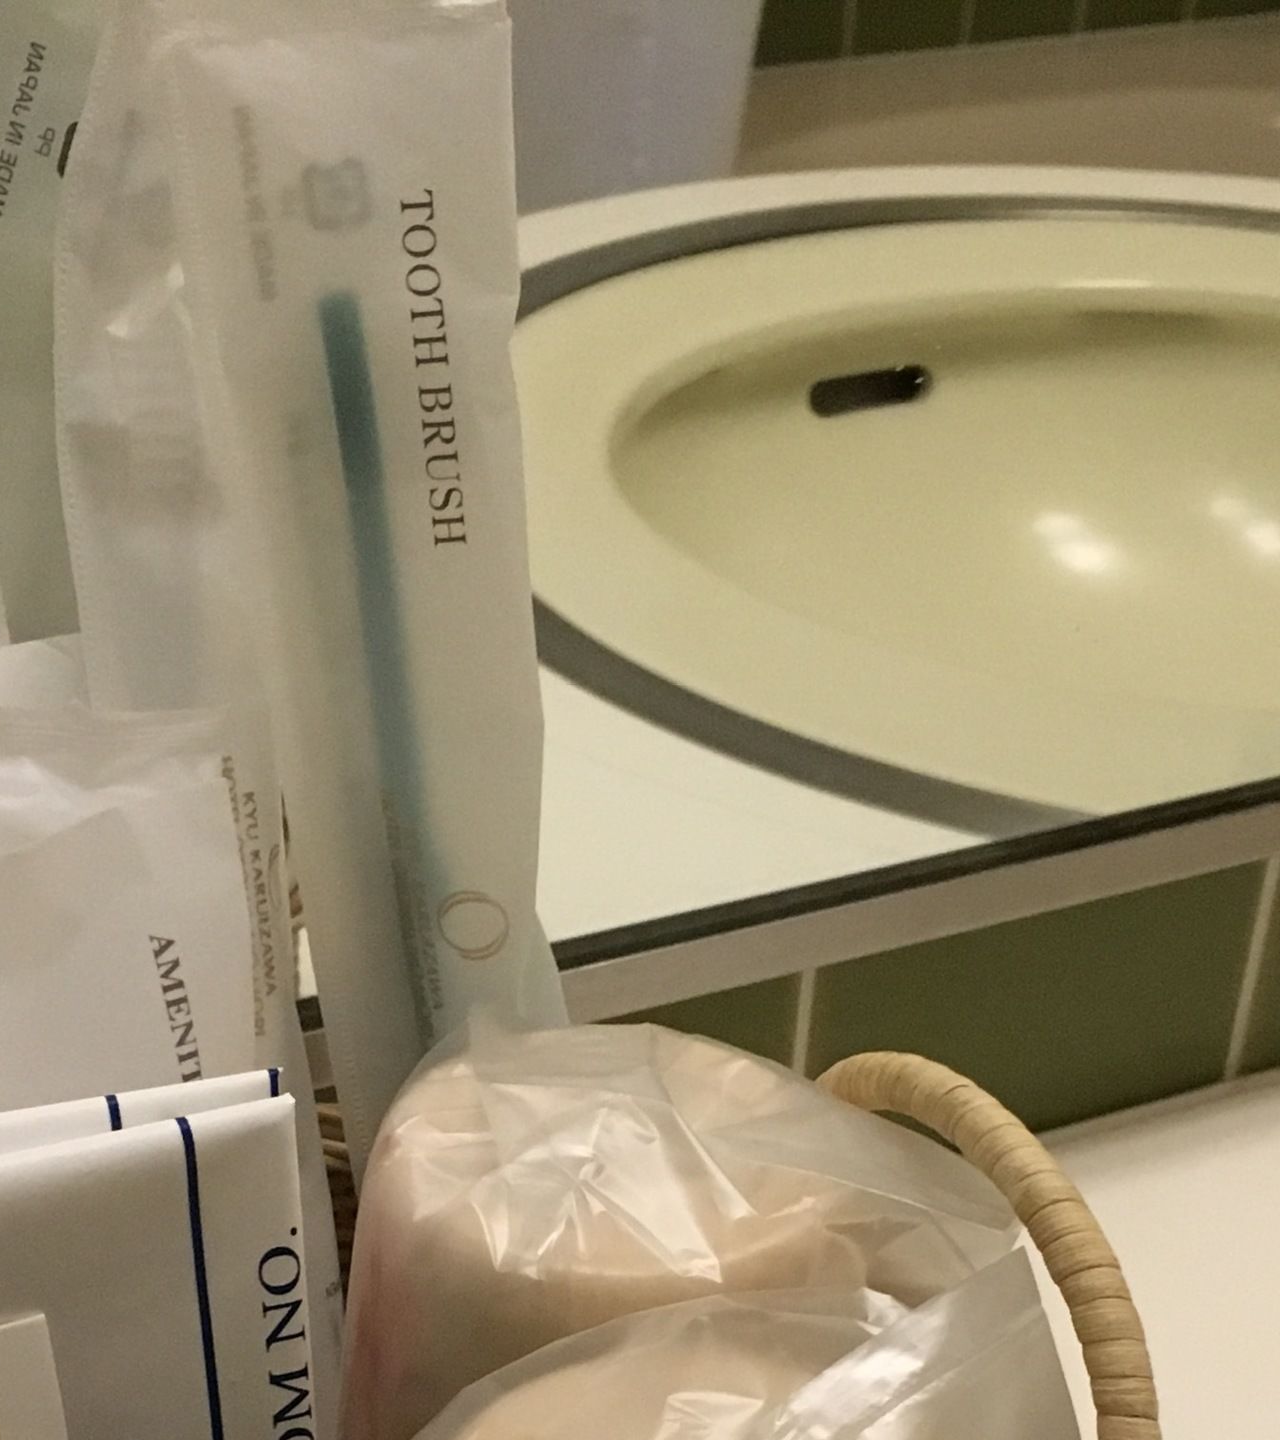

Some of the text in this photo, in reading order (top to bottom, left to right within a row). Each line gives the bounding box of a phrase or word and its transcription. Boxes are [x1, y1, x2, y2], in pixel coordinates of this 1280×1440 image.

[400, 189, 468, 547] TOOTH BRUSH
[258, 1226, 307, 1352] NO.
